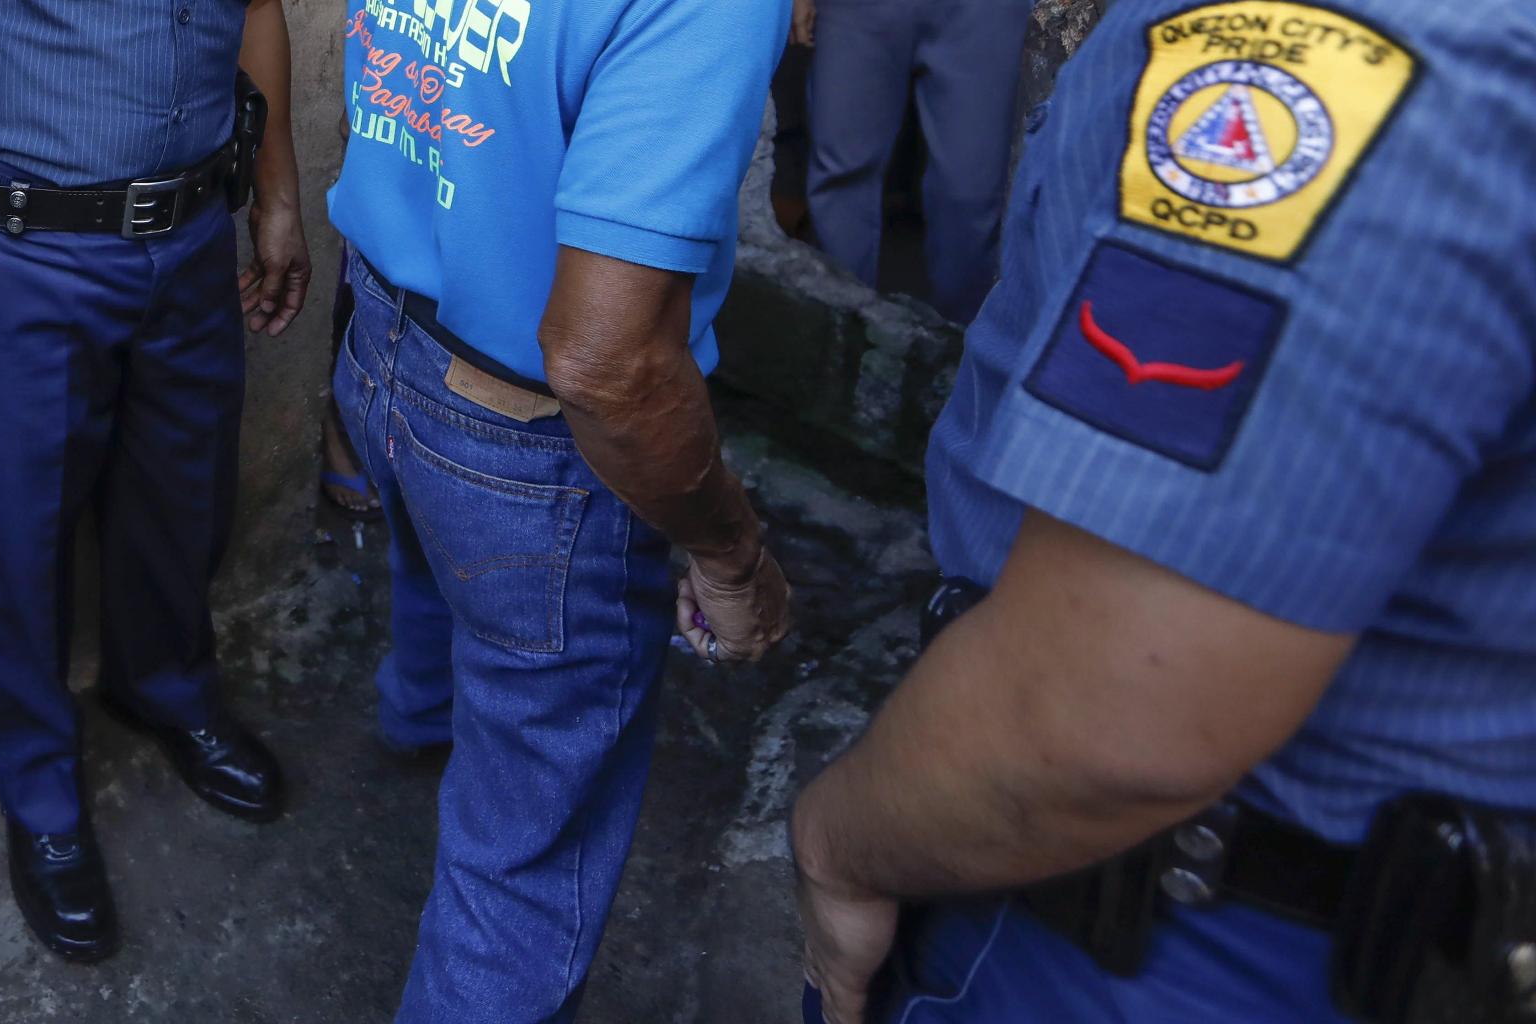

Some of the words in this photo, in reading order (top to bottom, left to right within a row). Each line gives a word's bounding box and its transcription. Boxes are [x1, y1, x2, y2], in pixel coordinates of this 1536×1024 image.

[1161, 13, 1271, 44] QUEZON
[1201, 34, 1308, 64] PRIDE
[1151, 197, 1258, 241] QCPD
